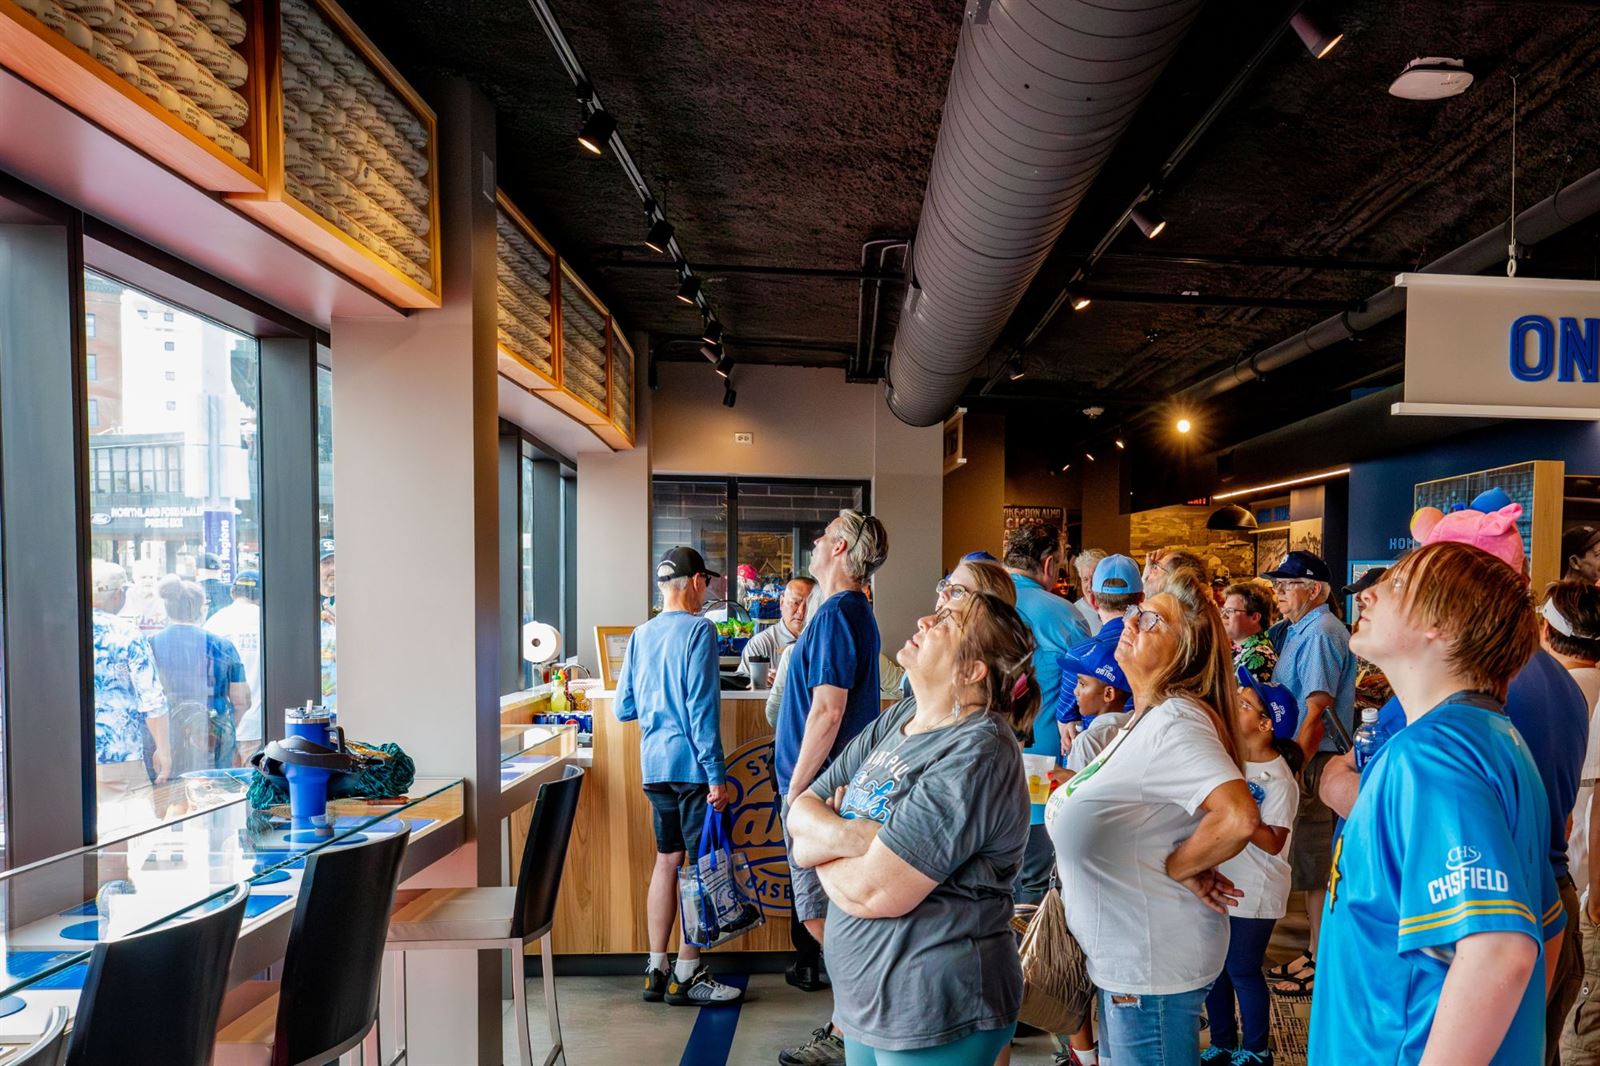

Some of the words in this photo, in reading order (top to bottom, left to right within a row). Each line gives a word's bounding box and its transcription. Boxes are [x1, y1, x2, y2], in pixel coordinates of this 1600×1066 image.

[1509, 314, 1600, 383] ON
[1389, 537, 1416, 550] HOM
[1447, 845, 1478, 862] CHS
[1427, 866, 1509, 905] CHSFIELD
